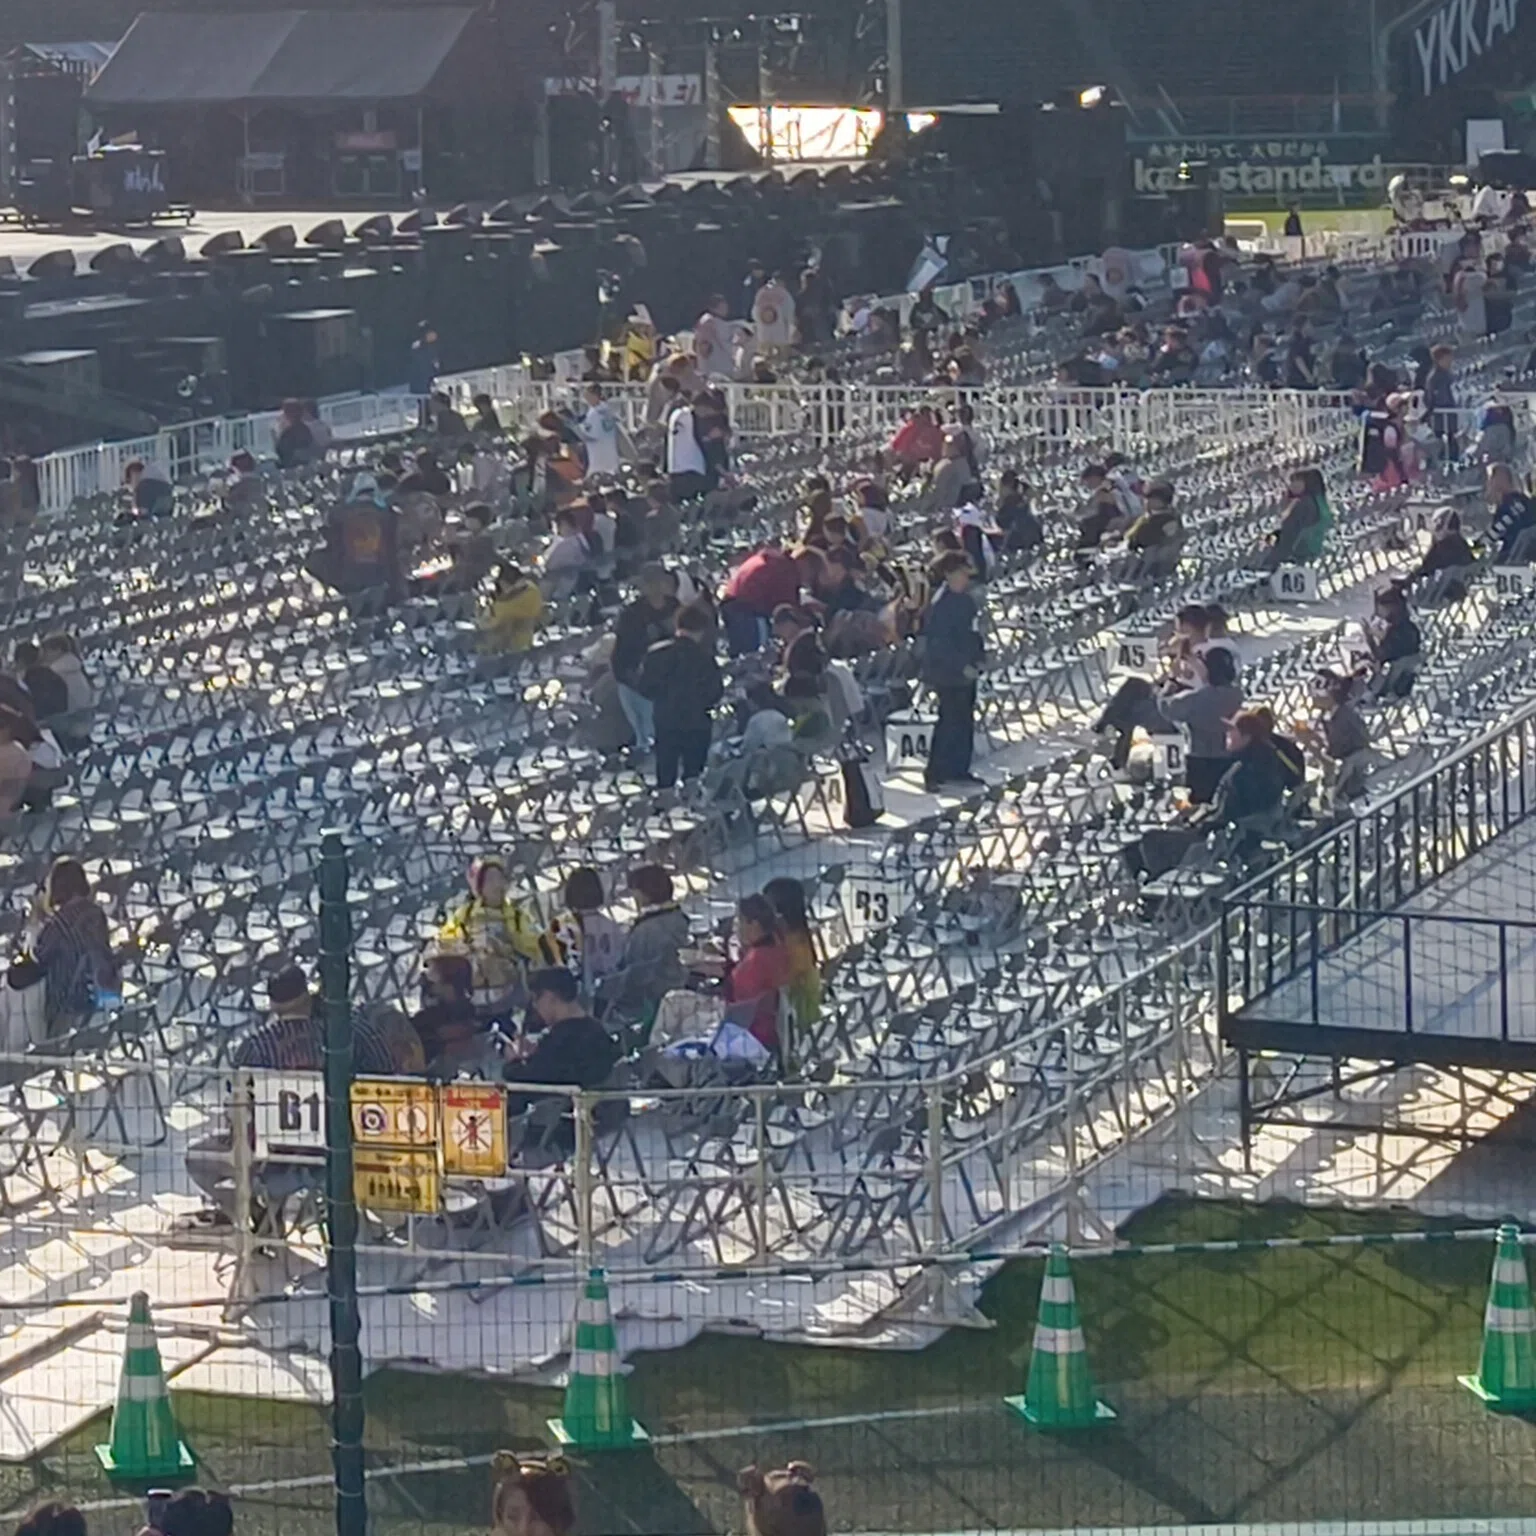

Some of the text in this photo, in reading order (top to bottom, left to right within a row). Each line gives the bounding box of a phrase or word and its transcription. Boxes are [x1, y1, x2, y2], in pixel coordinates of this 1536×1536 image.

[1281, 572, 1306, 594] A6
[1119, 644, 1145, 667] A5
[278, 1089, 321, 1132] B1
